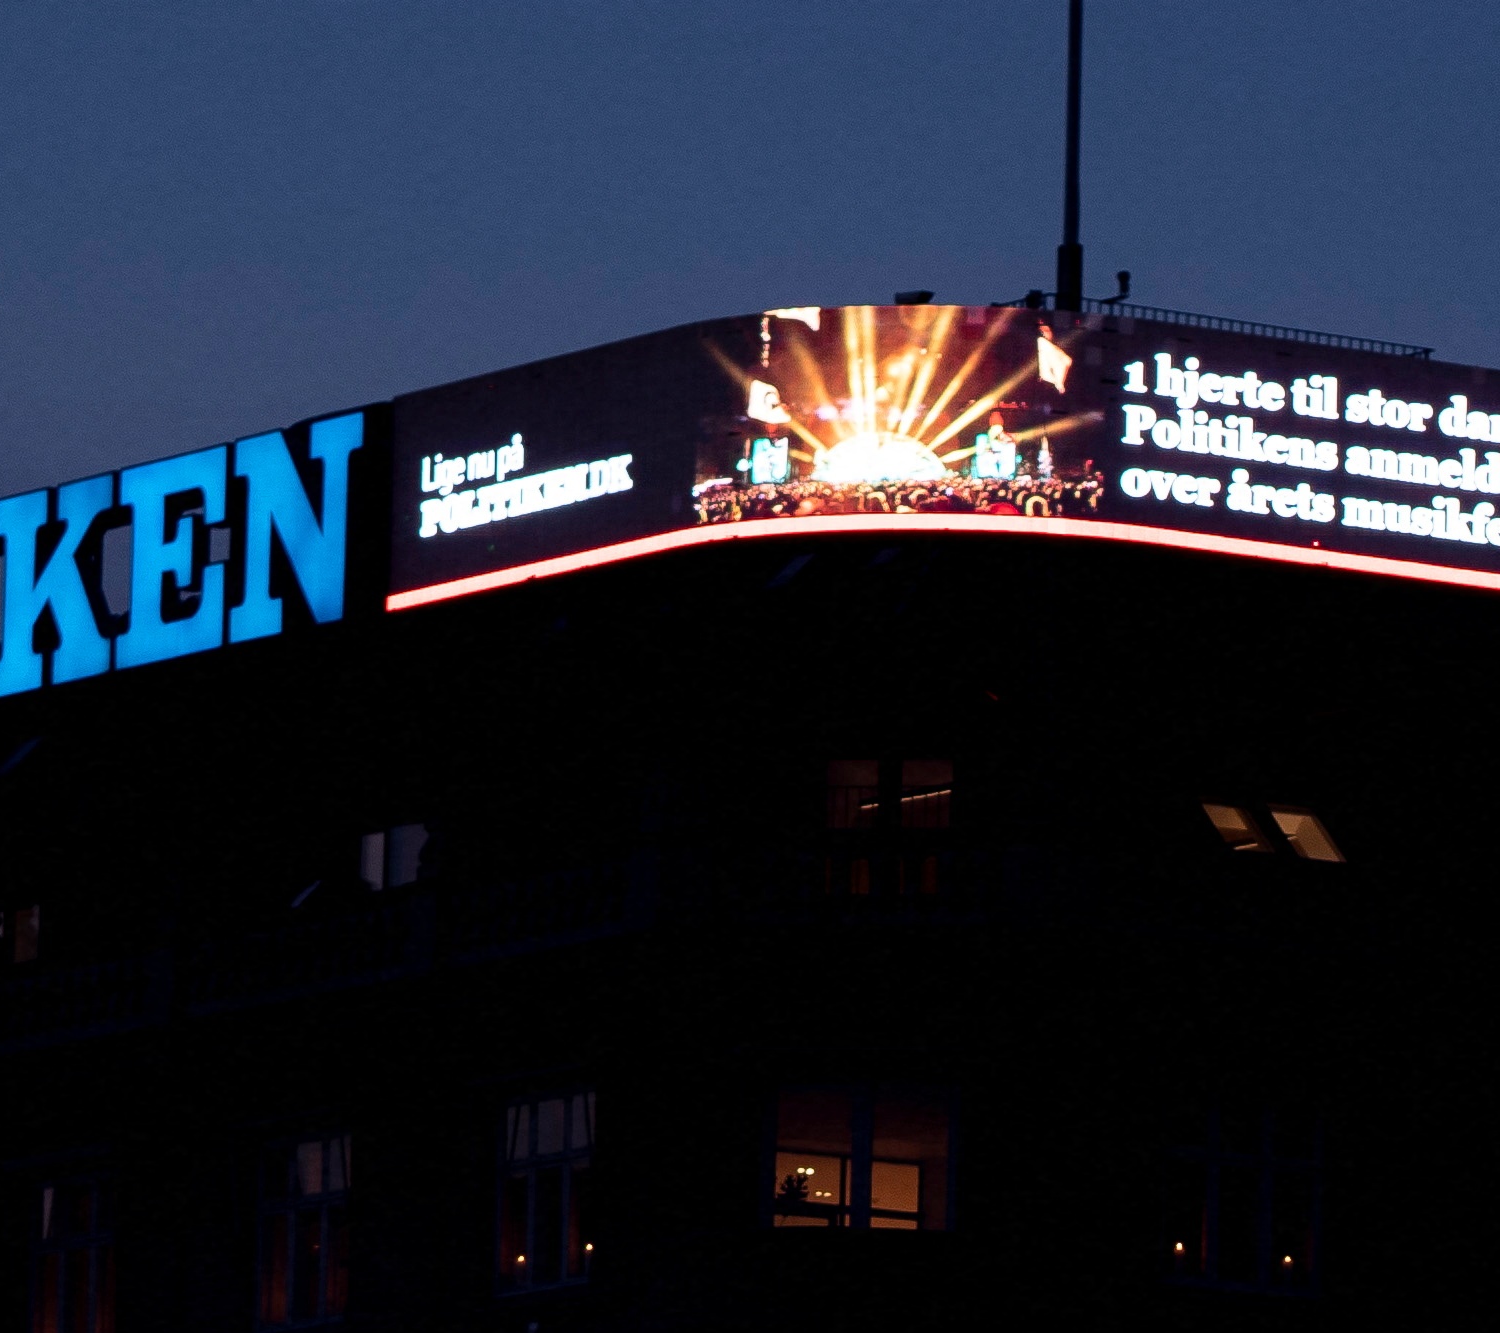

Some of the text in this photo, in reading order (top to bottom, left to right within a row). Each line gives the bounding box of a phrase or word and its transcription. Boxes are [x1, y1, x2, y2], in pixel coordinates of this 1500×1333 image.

[1123, 360, 1148, 393] 1
[1154, 353, 1286, 411] hjerte
[1290, 374, 1340, 420] til
[1345, 389, 1434, 432] stor
[421, 433, 525, 496] Lige nu på
[1121, 404, 1339, 471] Politikens
[1120, 467, 1222, 508] over
[1226, 467, 1335, 524] årets
